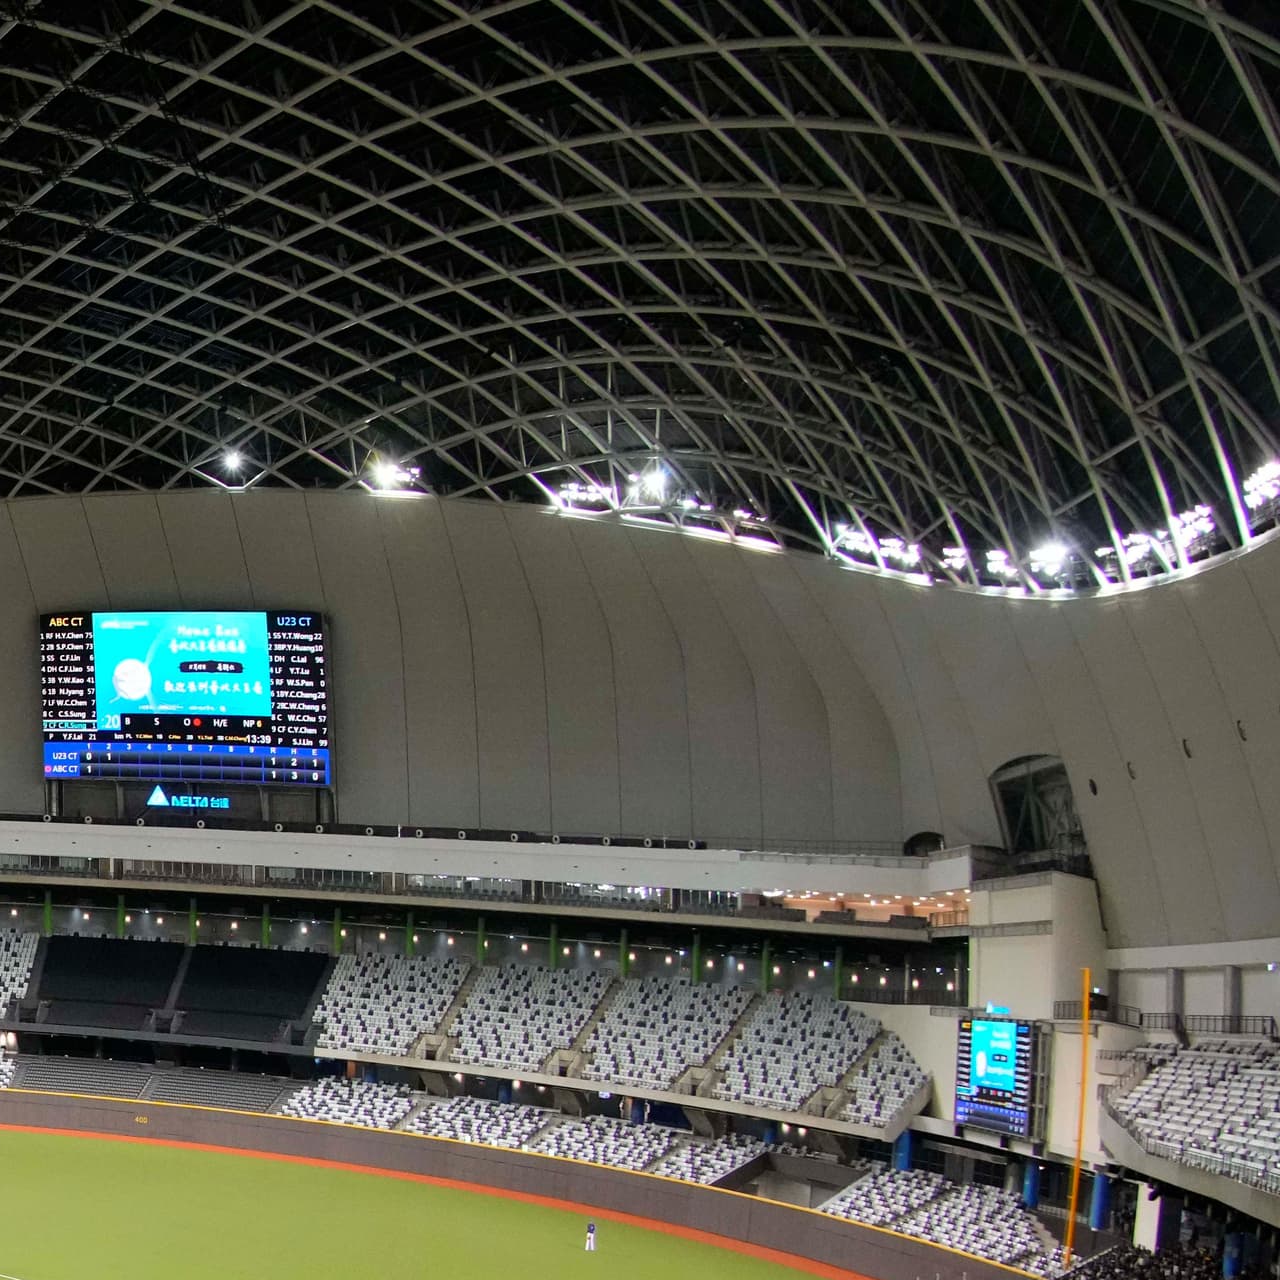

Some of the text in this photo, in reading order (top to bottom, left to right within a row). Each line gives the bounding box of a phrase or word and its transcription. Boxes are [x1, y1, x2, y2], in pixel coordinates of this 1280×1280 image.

[49, 618, 84, 626] ABC CT
[277, 617, 312, 626] U23 CT
[213, 719, 228, 727] H/E
[247, 735, 271, 744] 13:39
[172, 796, 208, 807] DELTA
